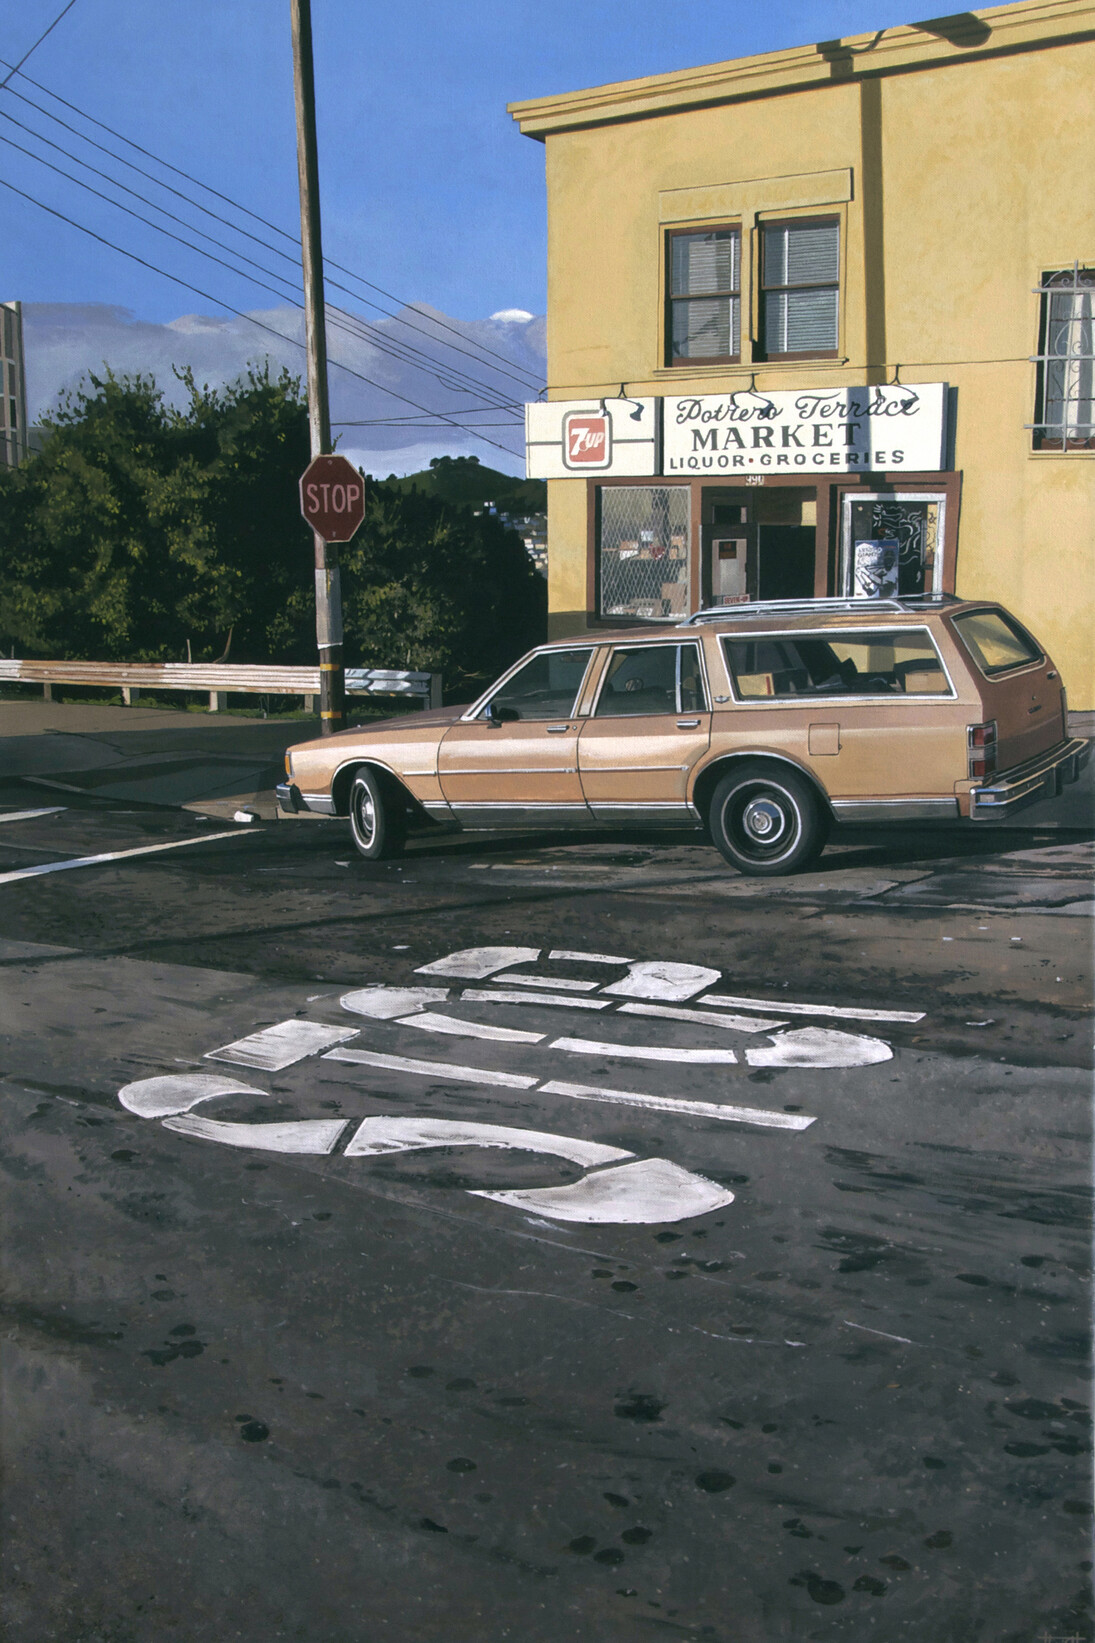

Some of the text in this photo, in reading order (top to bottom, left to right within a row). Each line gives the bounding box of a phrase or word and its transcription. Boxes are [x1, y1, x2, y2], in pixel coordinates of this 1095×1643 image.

[676, 392, 920, 425] Potrero Terrace
[691, 423, 861, 451] MARKET
[670, 450, 904, 469] LIQUOR GROCERIES
[306, 483, 360, 513] STOP
[117, 945, 926, 1225] STOP
